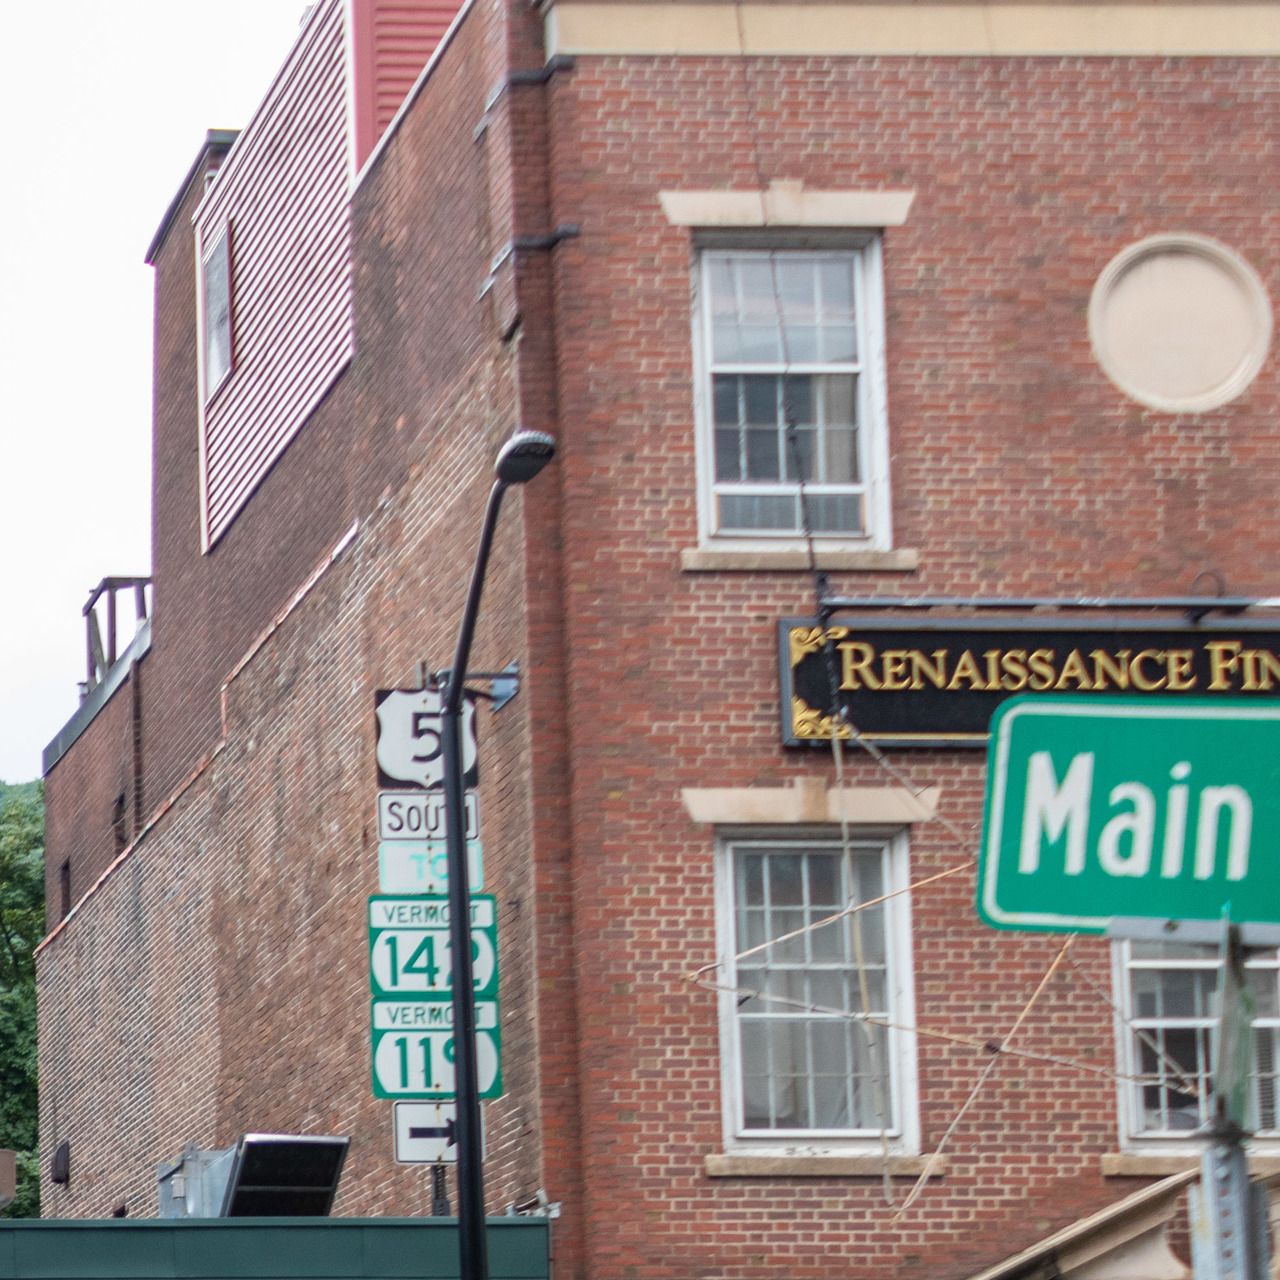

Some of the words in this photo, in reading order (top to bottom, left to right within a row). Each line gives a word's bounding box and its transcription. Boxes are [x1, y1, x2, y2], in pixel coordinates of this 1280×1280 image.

[837, 642, 1197, 691] RENAISSANCE
[411, 711, 444, 763] 5
[387, 801, 471, 832] SOU
[1018, 751, 1254, 882] Main
[383, 905, 480, 924] VERMOT
[387, 1006, 483, 1025] VERMOT
